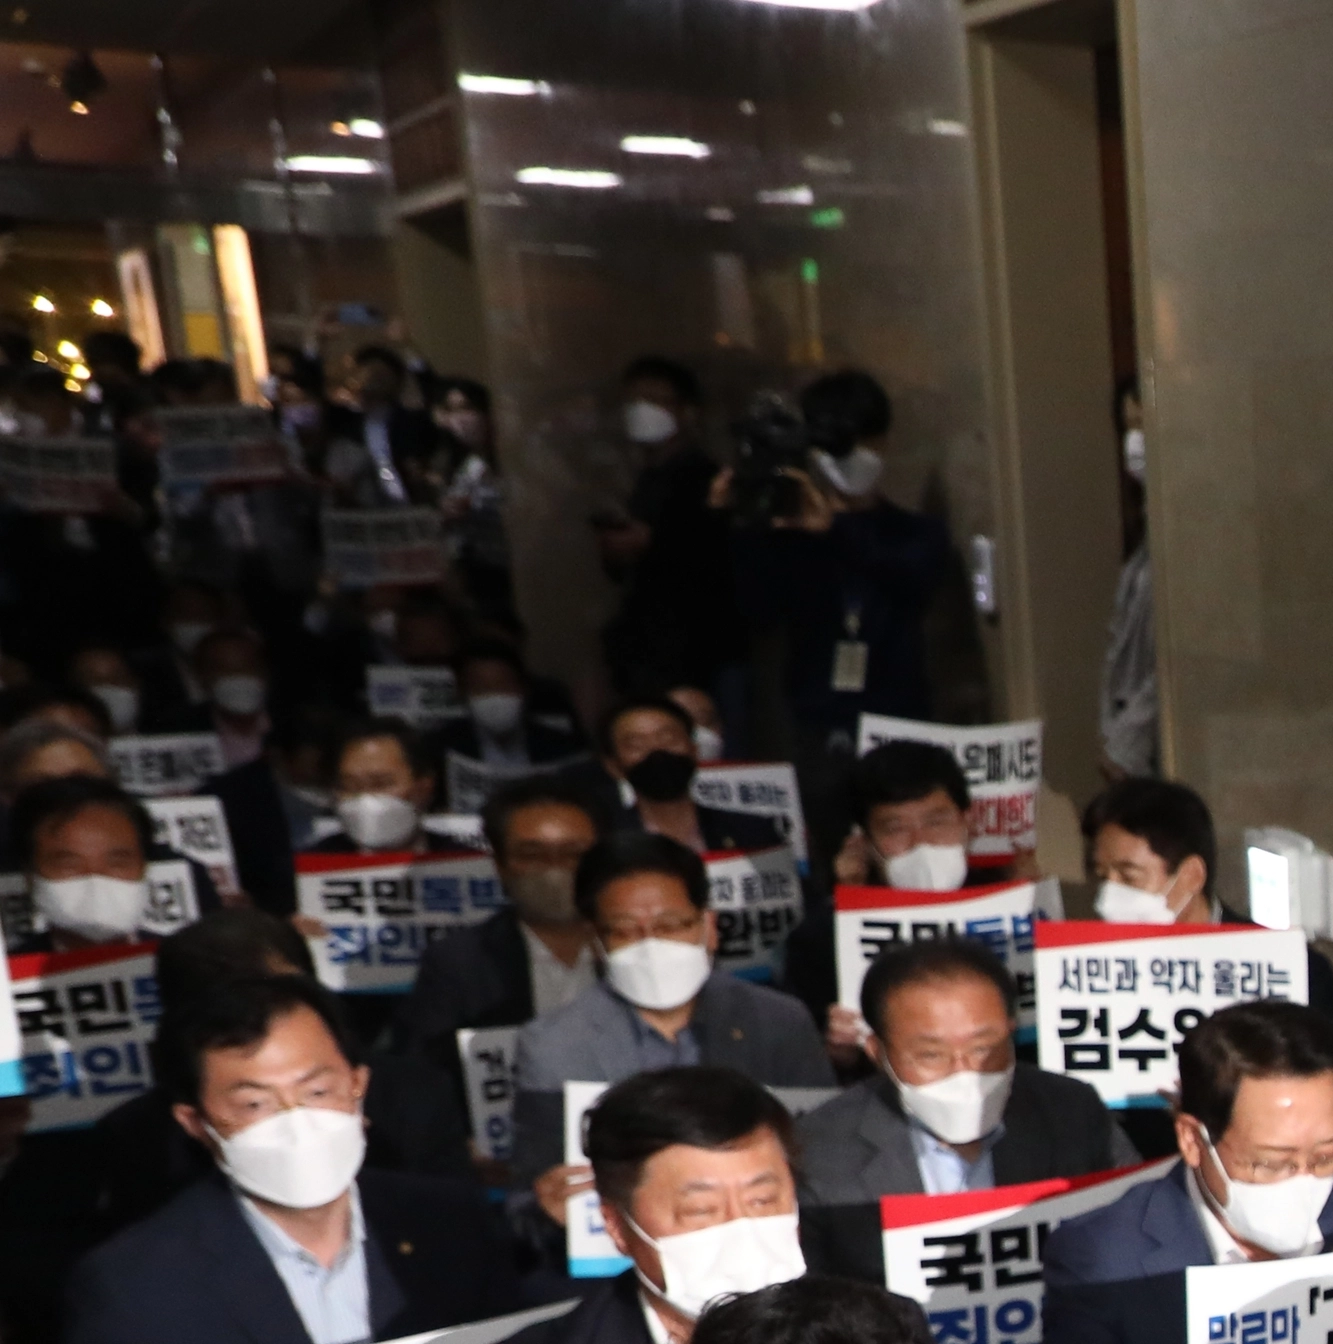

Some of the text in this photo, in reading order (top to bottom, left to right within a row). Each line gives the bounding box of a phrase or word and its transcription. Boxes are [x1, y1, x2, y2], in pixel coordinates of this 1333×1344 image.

[1059, 958, 1139, 994] 서민과
[1150, 959, 1203, 994] 약자
[1214, 960, 1291, 999] 울리는
